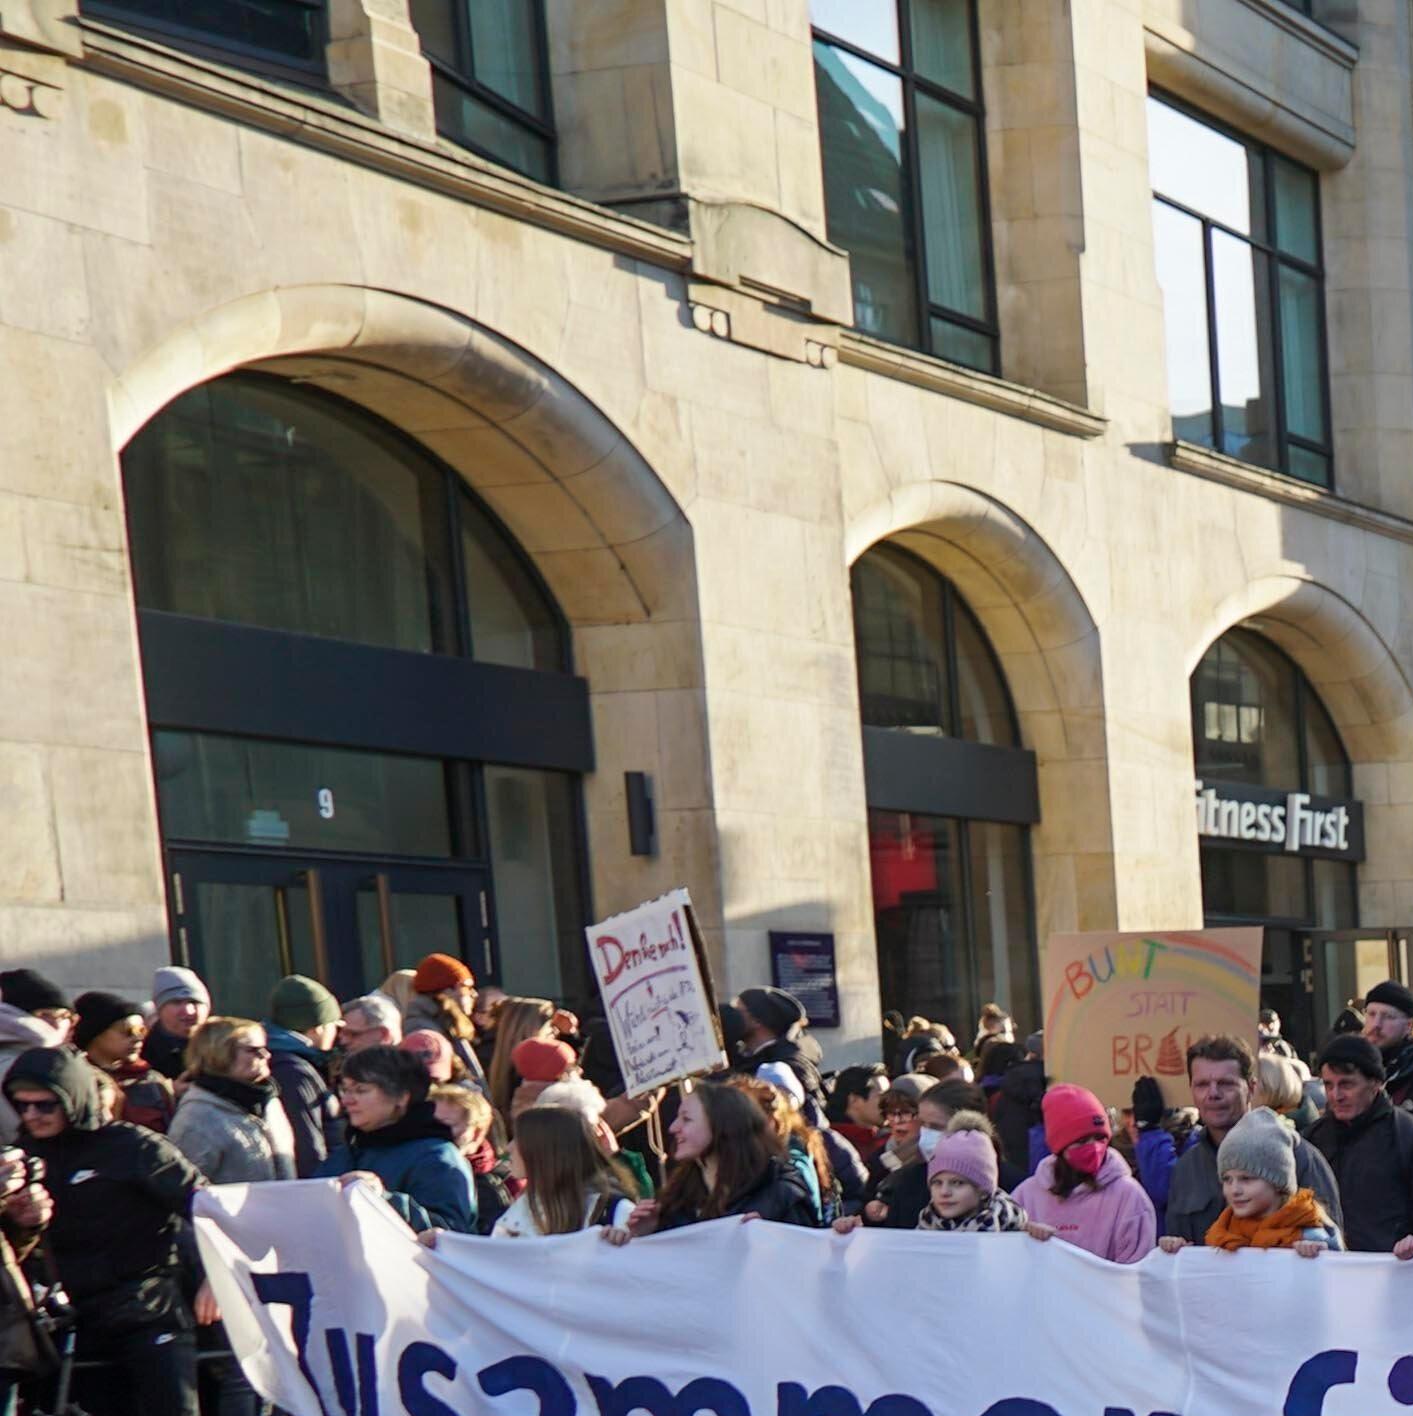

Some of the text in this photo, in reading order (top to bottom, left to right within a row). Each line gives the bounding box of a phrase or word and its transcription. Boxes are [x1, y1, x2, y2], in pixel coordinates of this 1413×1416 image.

[318, 788, 334, 818] 9
[1196, 780, 1349, 851] itness First
[1065, 938, 1169, 999] BUNT
[1127, 991, 1198, 1018] STATT
